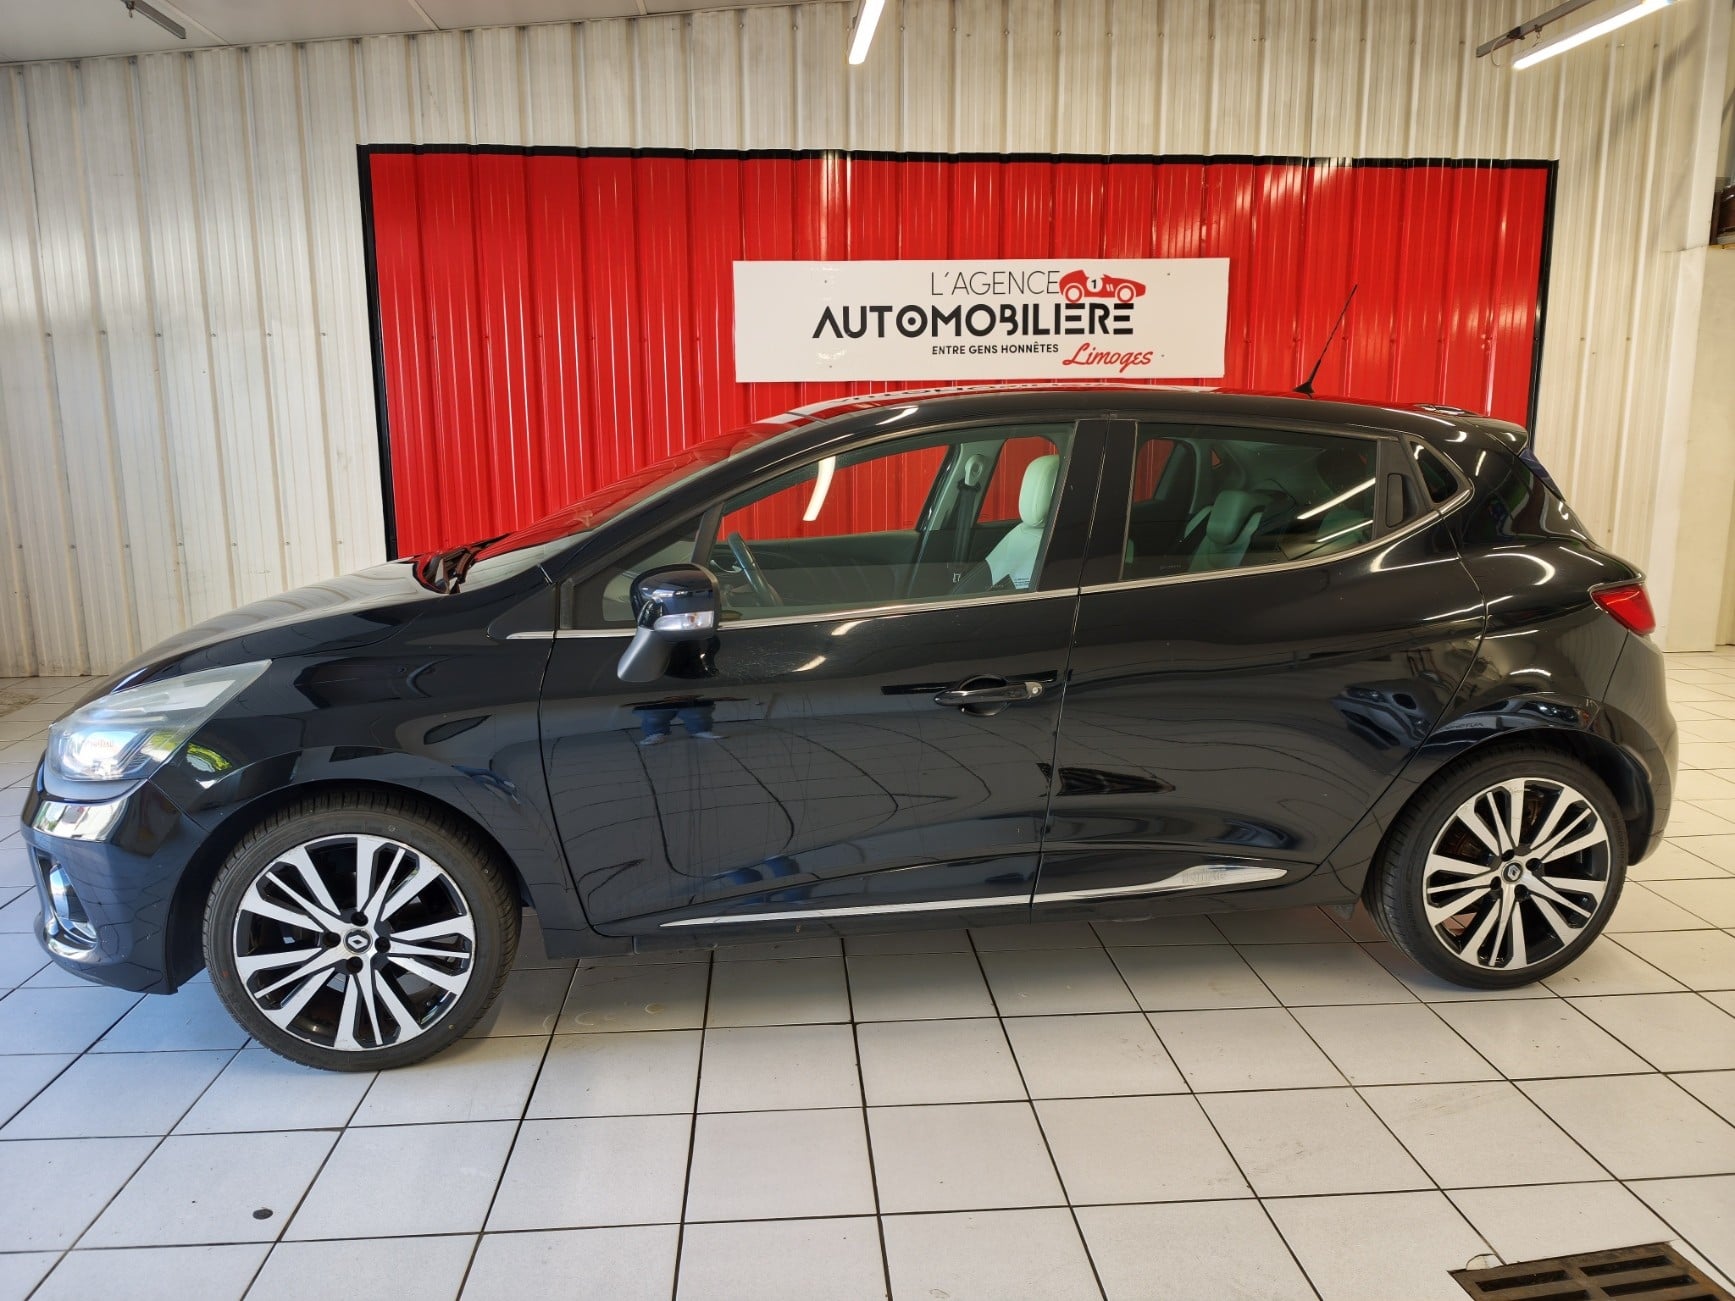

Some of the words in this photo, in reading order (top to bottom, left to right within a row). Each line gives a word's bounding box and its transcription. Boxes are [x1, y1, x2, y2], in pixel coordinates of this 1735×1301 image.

[931, 345, 966, 355] ENTRE
[968, 344, 998, 355] GENS
[1000, 341, 1059, 354] HONNÊTES
[1062, 342, 1154, 373] Limoges
